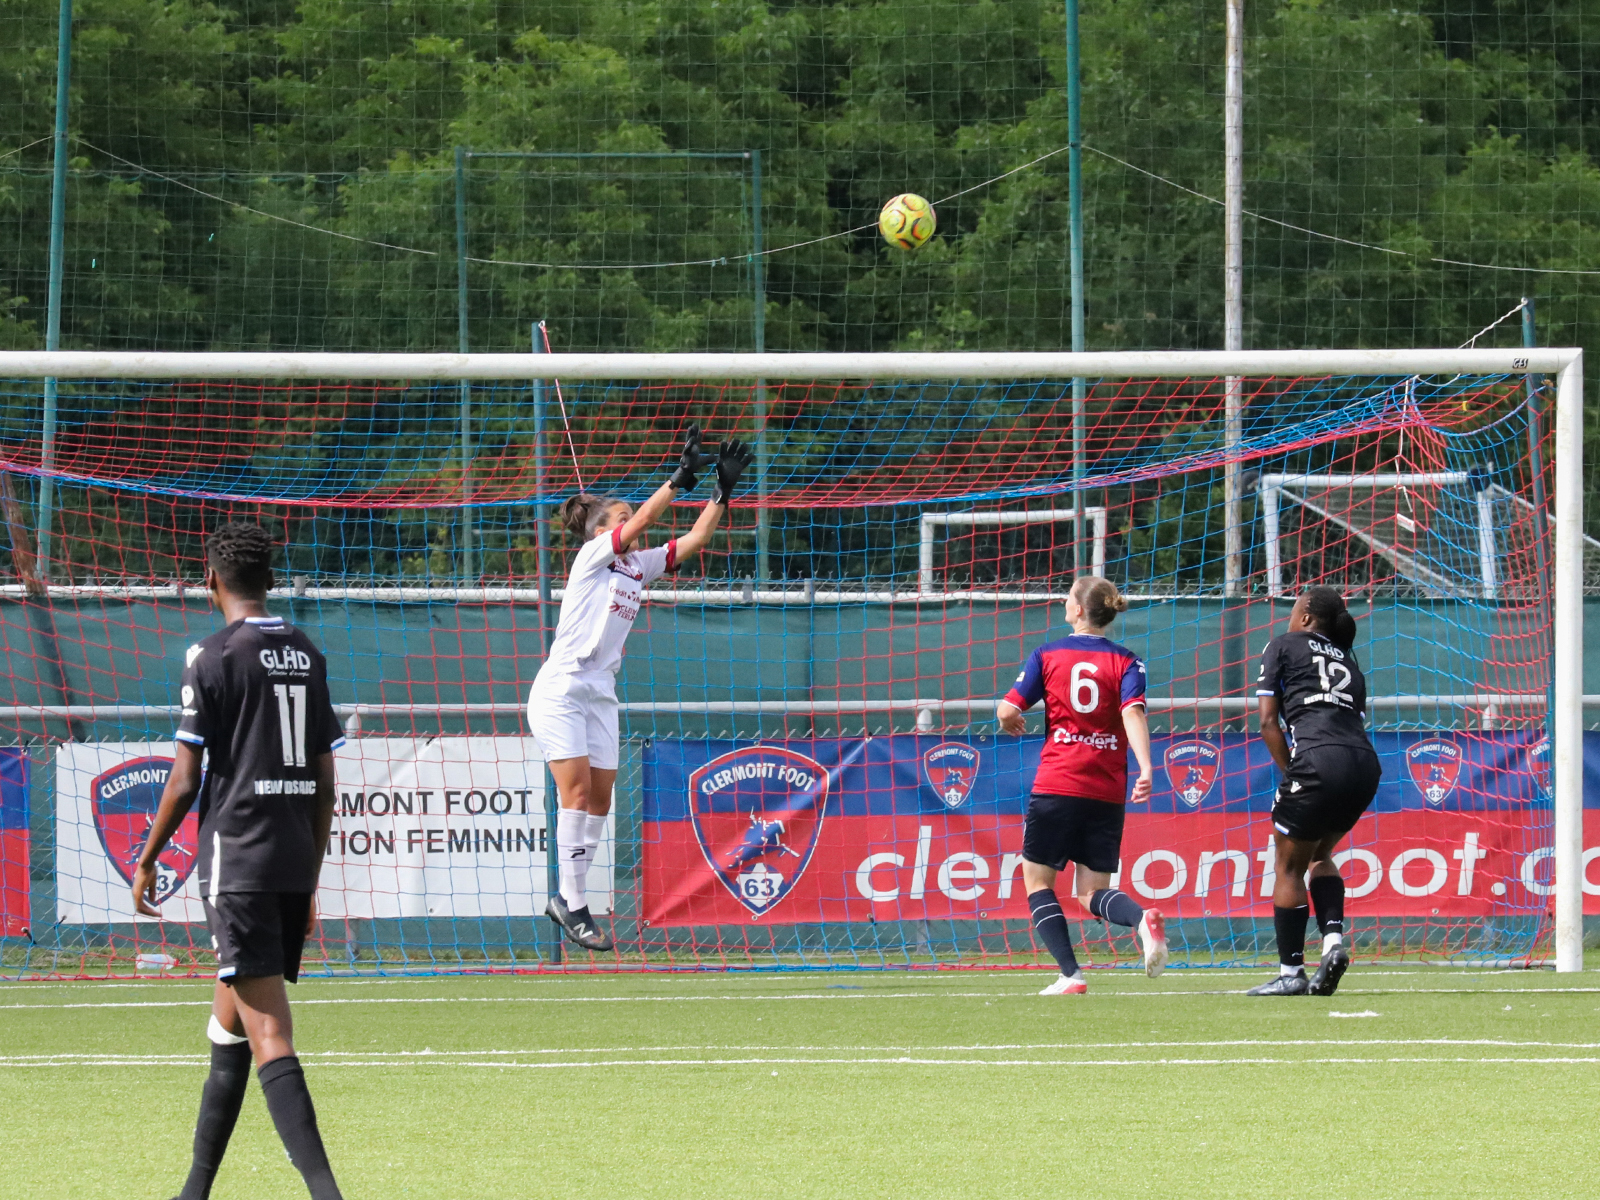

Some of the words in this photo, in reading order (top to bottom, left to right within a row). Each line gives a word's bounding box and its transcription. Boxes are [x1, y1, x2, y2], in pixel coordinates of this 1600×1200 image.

[259, 647, 311, 670] GLHD
[1070, 661, 1099, 714] 6
[1312, 655, 1354, 703] 12
[273, 684, 307, 767] 11
[929, 748, 959, 761] CLERMONT
[959, 749, 975, 760] FOOT
[1168, 745, 1199, 759] CLERMONT
[1199, 746, 1216, 759] FOOT
[100, 768, 169, 799] CLERMONT
[254, 779, 283, 795] NEW
[701, 762, 776, 796] CLERMONT
[778, 765, 816, 792] FOOT
[334, 791, 434, 818] MONT
[446, 790, 533, 815] FOOT
[947, 794, 959, 802] 63
[1186, 792, 1199, 800] 63
[1429, 789, 1442, 799] 63
[326, 830, 394, 856] TION
[156, 874, 170, 891] 3
[744, 878, 775, 898] 63
